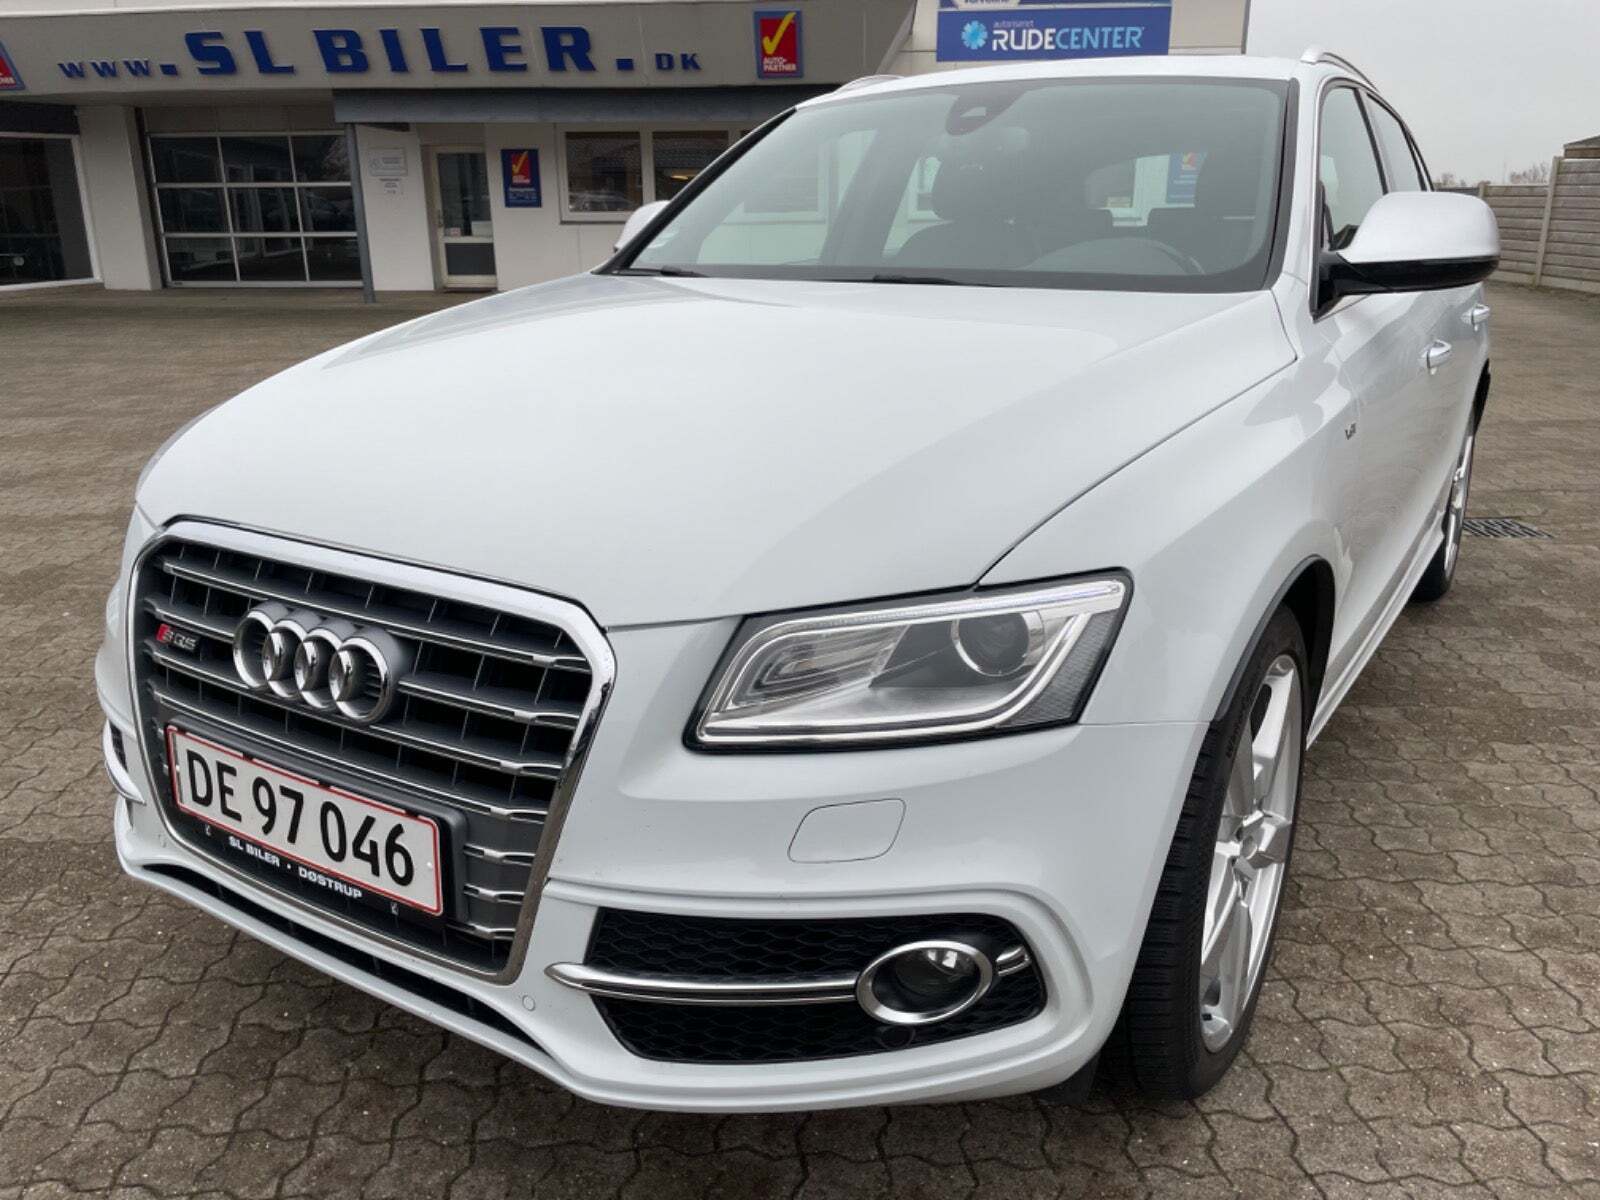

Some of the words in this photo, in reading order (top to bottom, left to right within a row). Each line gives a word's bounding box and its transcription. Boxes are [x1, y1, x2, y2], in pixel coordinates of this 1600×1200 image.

[992, 27, 1143, 51] RUDECENTER
[763, 64, 797, 72] PARTNER
[186, 749, 242, 823] DE
[252, 776, 304, 844] 97
[320, 801, 414, 887] 046
[228, 835, 244, 851] SL
[245, 843, 281, 867] BILER
[298, 865, 363, 899] DØSTRUP
